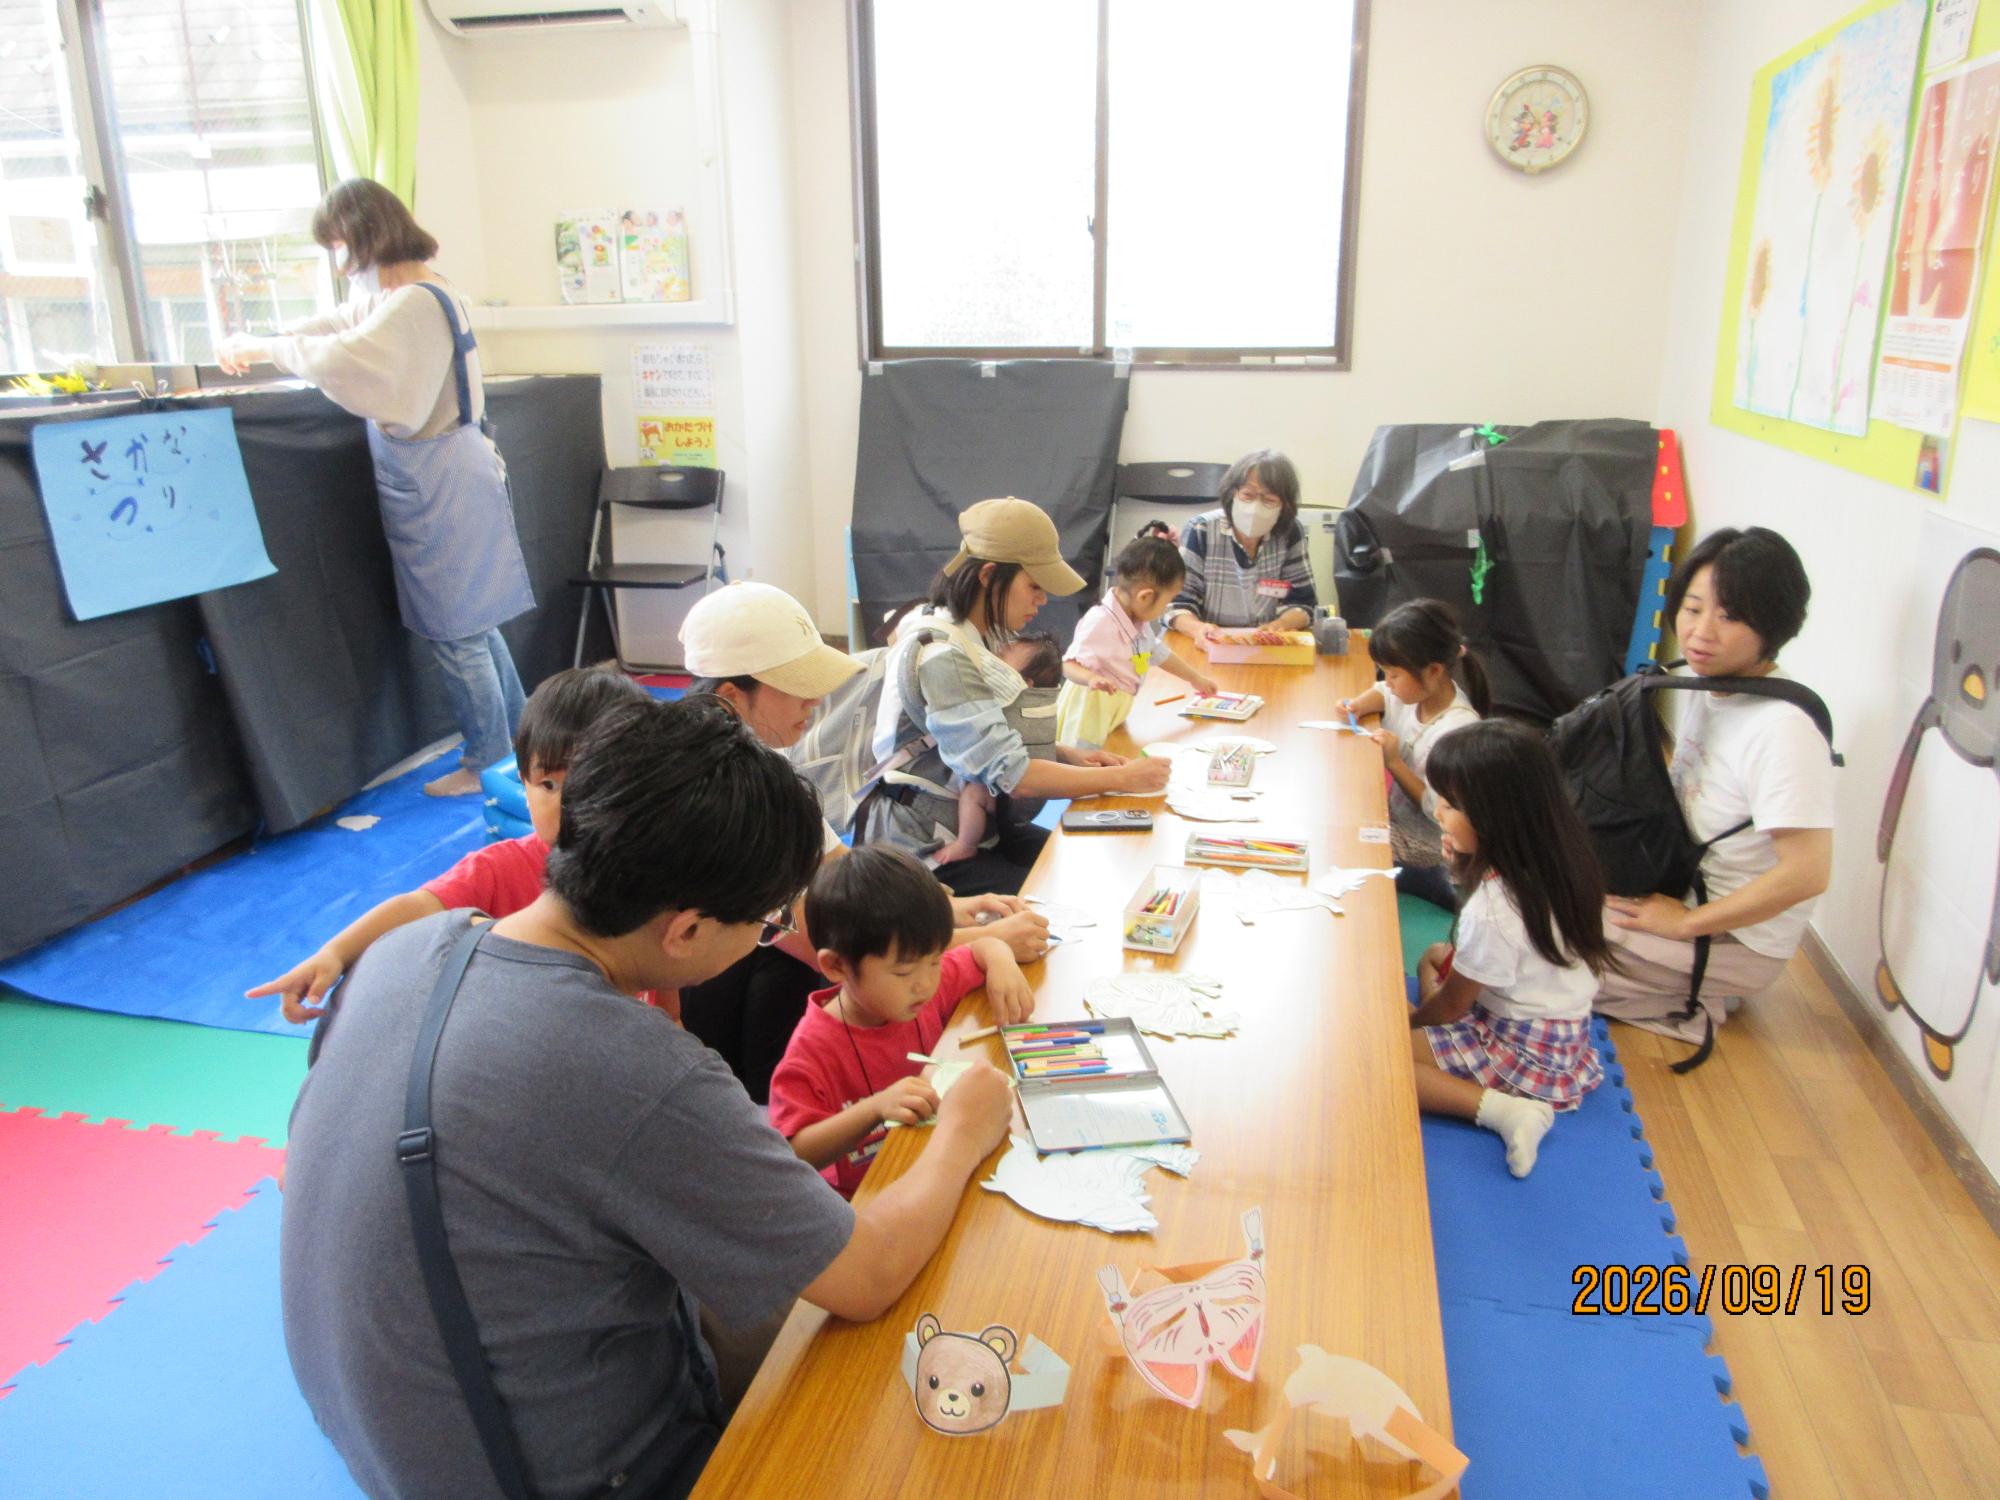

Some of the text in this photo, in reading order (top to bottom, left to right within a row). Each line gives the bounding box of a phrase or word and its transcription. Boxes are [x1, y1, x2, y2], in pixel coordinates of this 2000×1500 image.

[664, 421, 713, 433] おかたづけ
